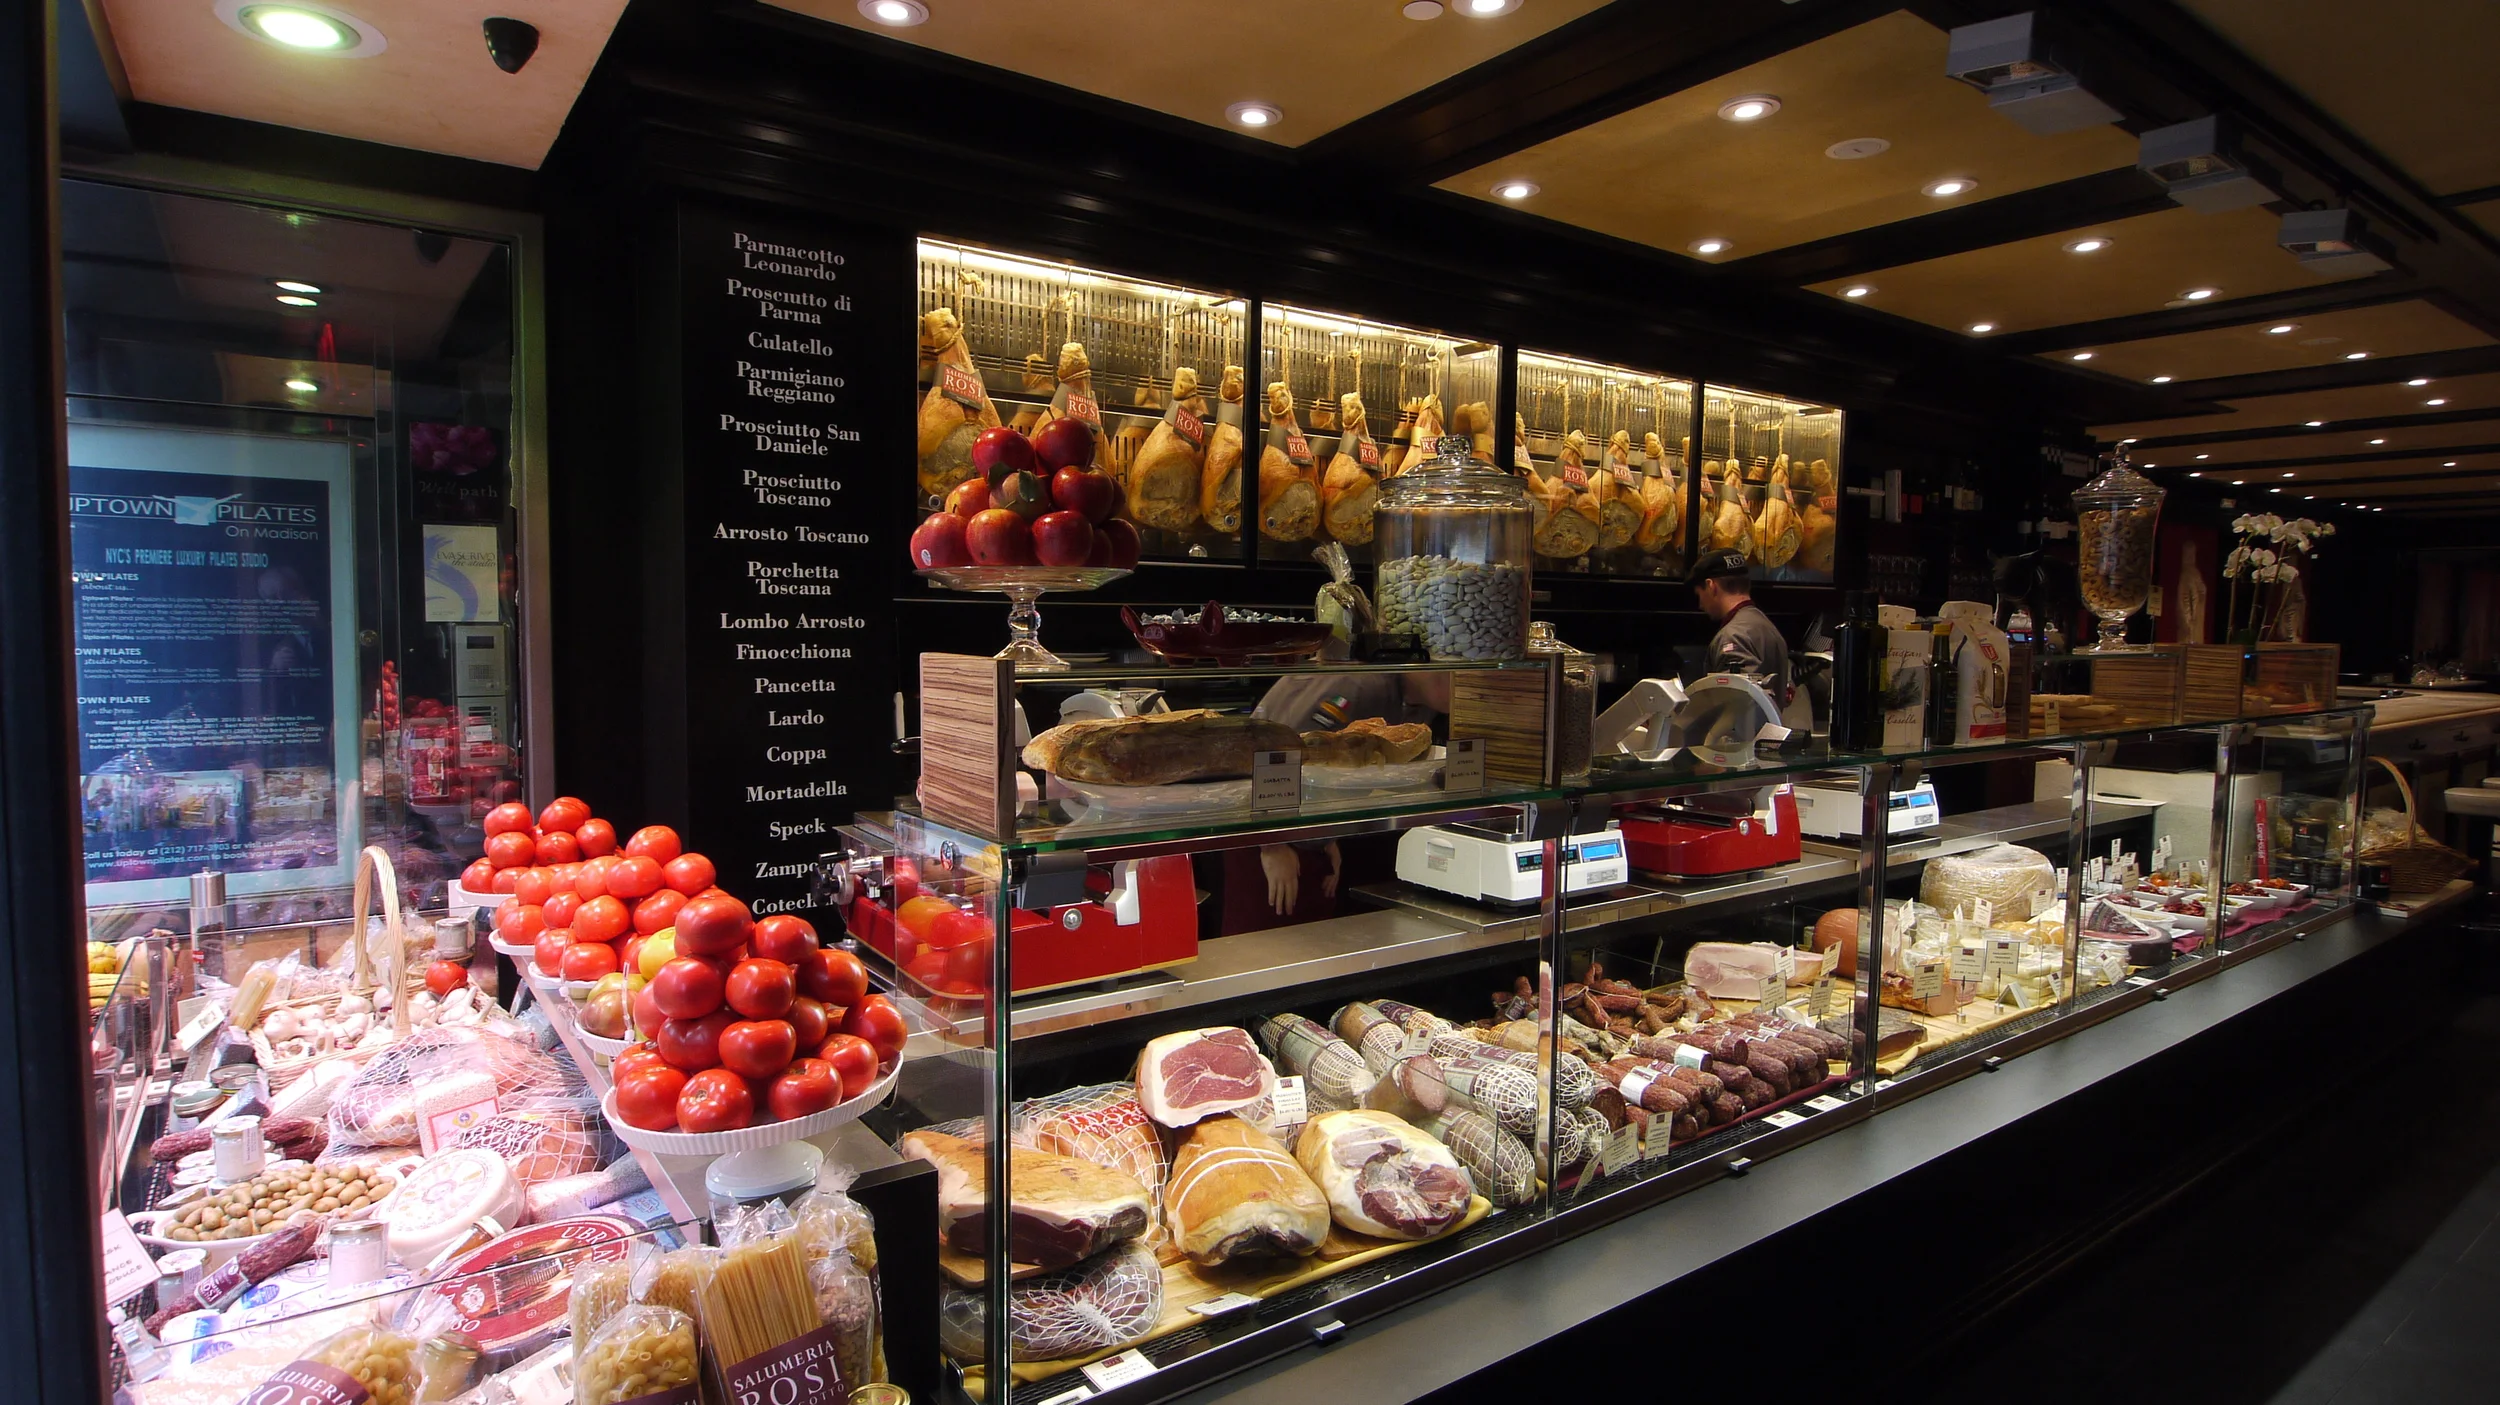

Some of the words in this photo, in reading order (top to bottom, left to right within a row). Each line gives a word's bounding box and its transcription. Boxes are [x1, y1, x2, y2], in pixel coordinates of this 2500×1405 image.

[733, 232, 845, 266] Parmacotto
[744, 252, 836, 281] Leonardo
[726, 278, 827, 308] Prosciutto
[834, 296, 851, 312] di
[760, 301, 821, 324] Parma
[748, 331, 833, 357] Culatello
[736, 361, 845, 388] Parmigiano
[748, 380, 835, 404] Reggiano
[945, 374, 982, 398] ROSI
[1068, 400, 1098, 418] ROS
[720, 414, 820, 438] Prosciutto
[827, 424, 860, 441] San
[1176, 416, 1204, 438] ROSI
[756, 435, 828, 456] Daniele
[743, 469, 841, 491] Prosciutto
[459, 485, 499, 500] path
[754, 487, 831, 507] Toscano
[218, 504, 317, 523] PILATES
[226, 525, 250, 538] On
[254, 527, 318, 540] Madison
[713, 522, 788, 541] Arrosto
[795, 526, 869, 544] Toscano
[105, 547, 131, 564] NYC'S
[135, 549, 173, 565] PREMIERE
[176, 550, 205, 566] LUXURY
[209, 551, 238, 567] PILATES
[241, 552, 268, 568] STUDIO
[102, 573, 139, 581] PILATES
[747, 561, 839, 580] Porchetta
[756, 578, 831, 596] Toscana
[720, 612, 789, 629] Lombo
[795, 613, 865, 629] Arrosto
[102, 648, 141, 656] PILATES
[736, 643, 852, 660] Finocchiona
[755, 678, 836, 693] Pancetta
[109, 695, 151, 704] PILATES
[768, 711, 824, 726] Lardo
[766, 746, 827, 765] Coppa
[746, 781, 848, 802] Mortadella
[769, 818, 826, 841] Speck
[88, 854, 210, 869] www.uptownpilates.com
[211, 853, 221, 861] to
[223, 851, 248, 860] book
[249, 850, 272, 859] your
[102, 850, 114, 859] us
[115, 849, 145, 859] today
[148, 848, 158, 856] at
[160, 845, 185, 855] (212)
[187, 843, 230, 853] 717-3903
[243, 840, 262, 849] visit
[264, 840, 275, 848] us
[734, 1340, 835, 1393] SALUMERIA
